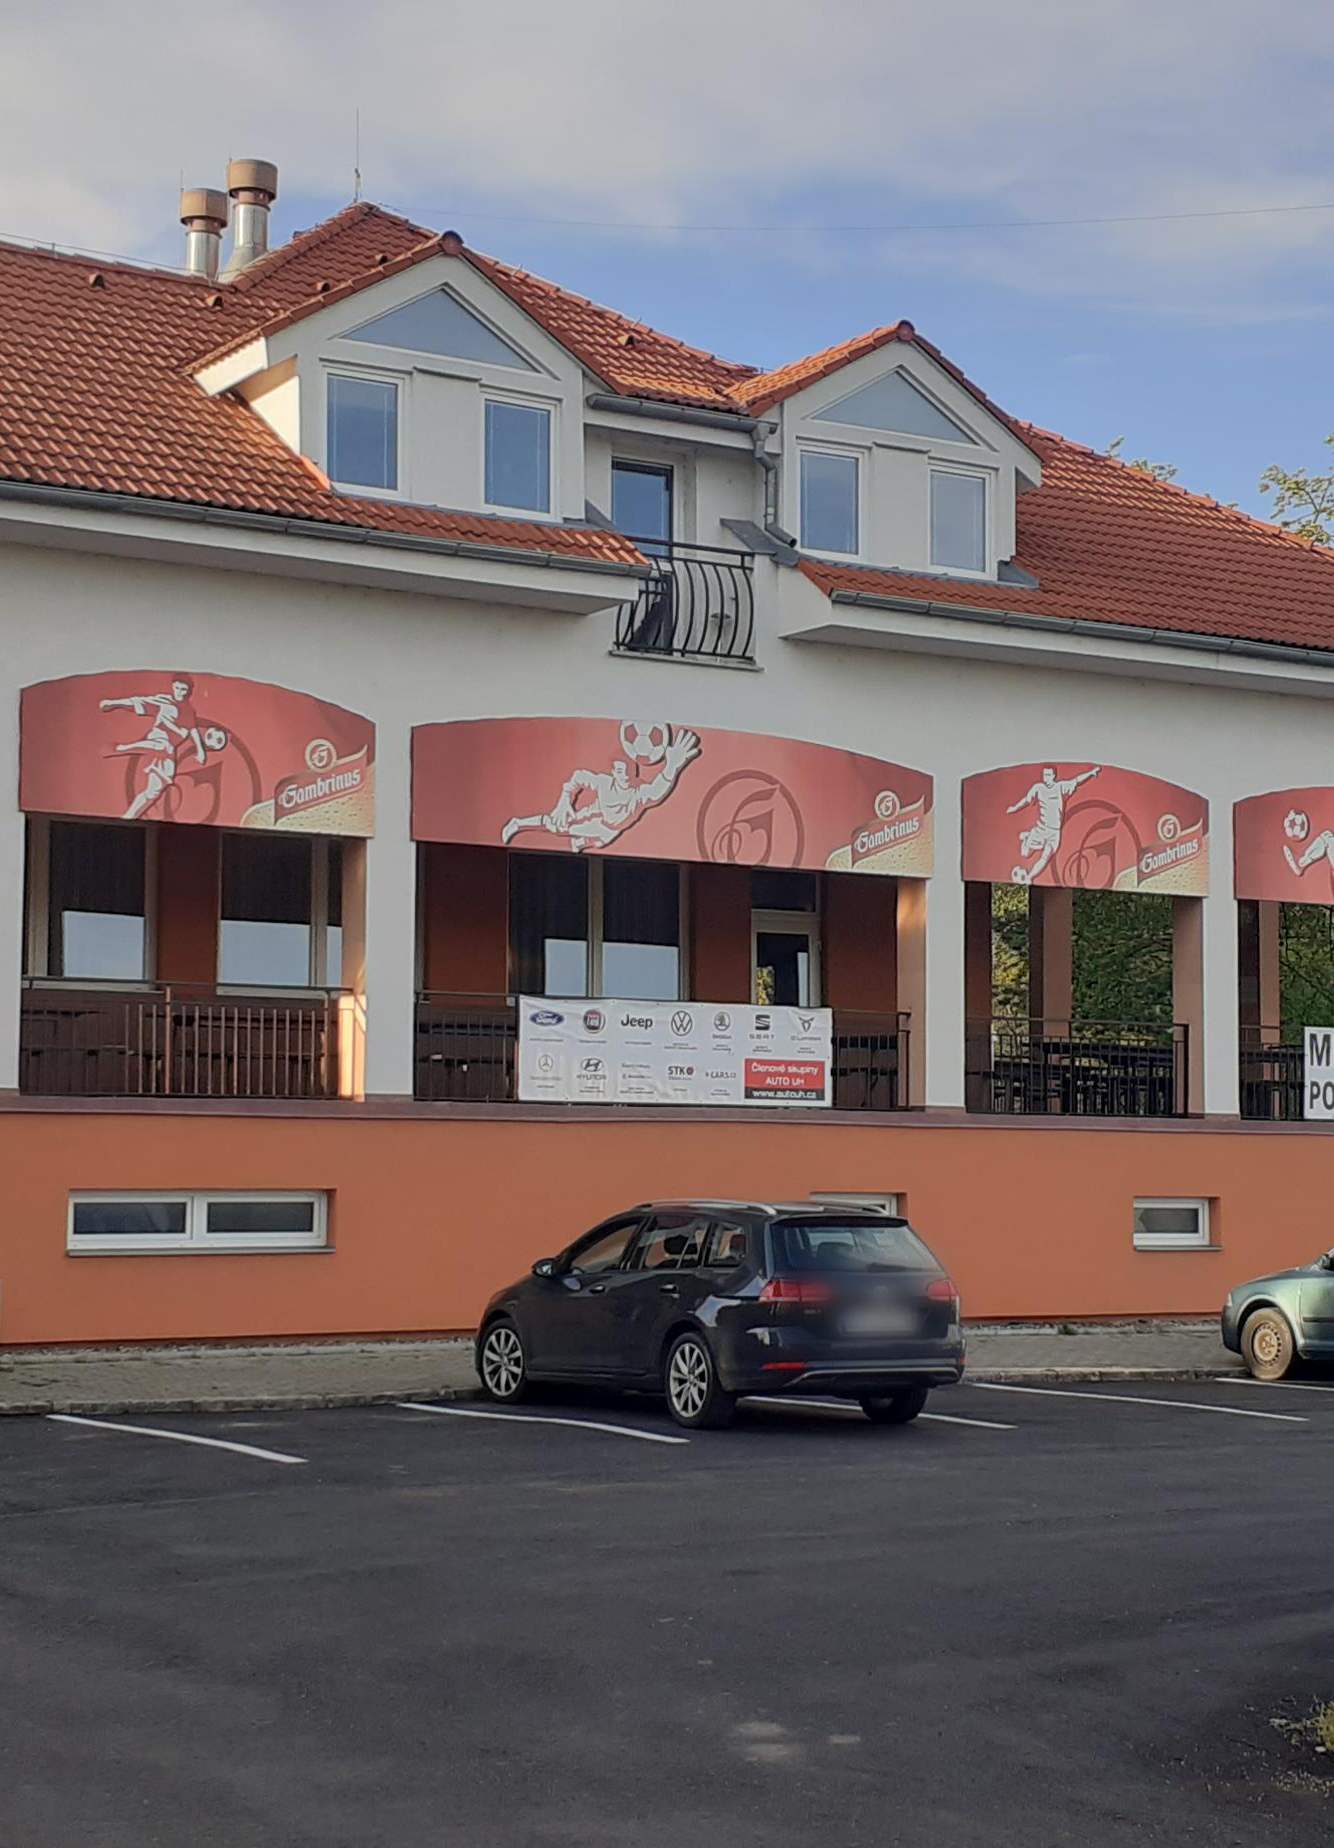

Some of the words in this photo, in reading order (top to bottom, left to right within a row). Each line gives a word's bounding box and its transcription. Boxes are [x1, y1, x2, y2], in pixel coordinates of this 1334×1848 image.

[278, 768, 361, 808] Gambrinus
[854, 817, 919, 853] Gambrinus
[1139, 838, 1199, 873] Gambrinus
[620, 1014, 654, 1030] Jeep
[668, 1066, 685, 1076] STK
[765, 1076, 790, 1085] AUTO
